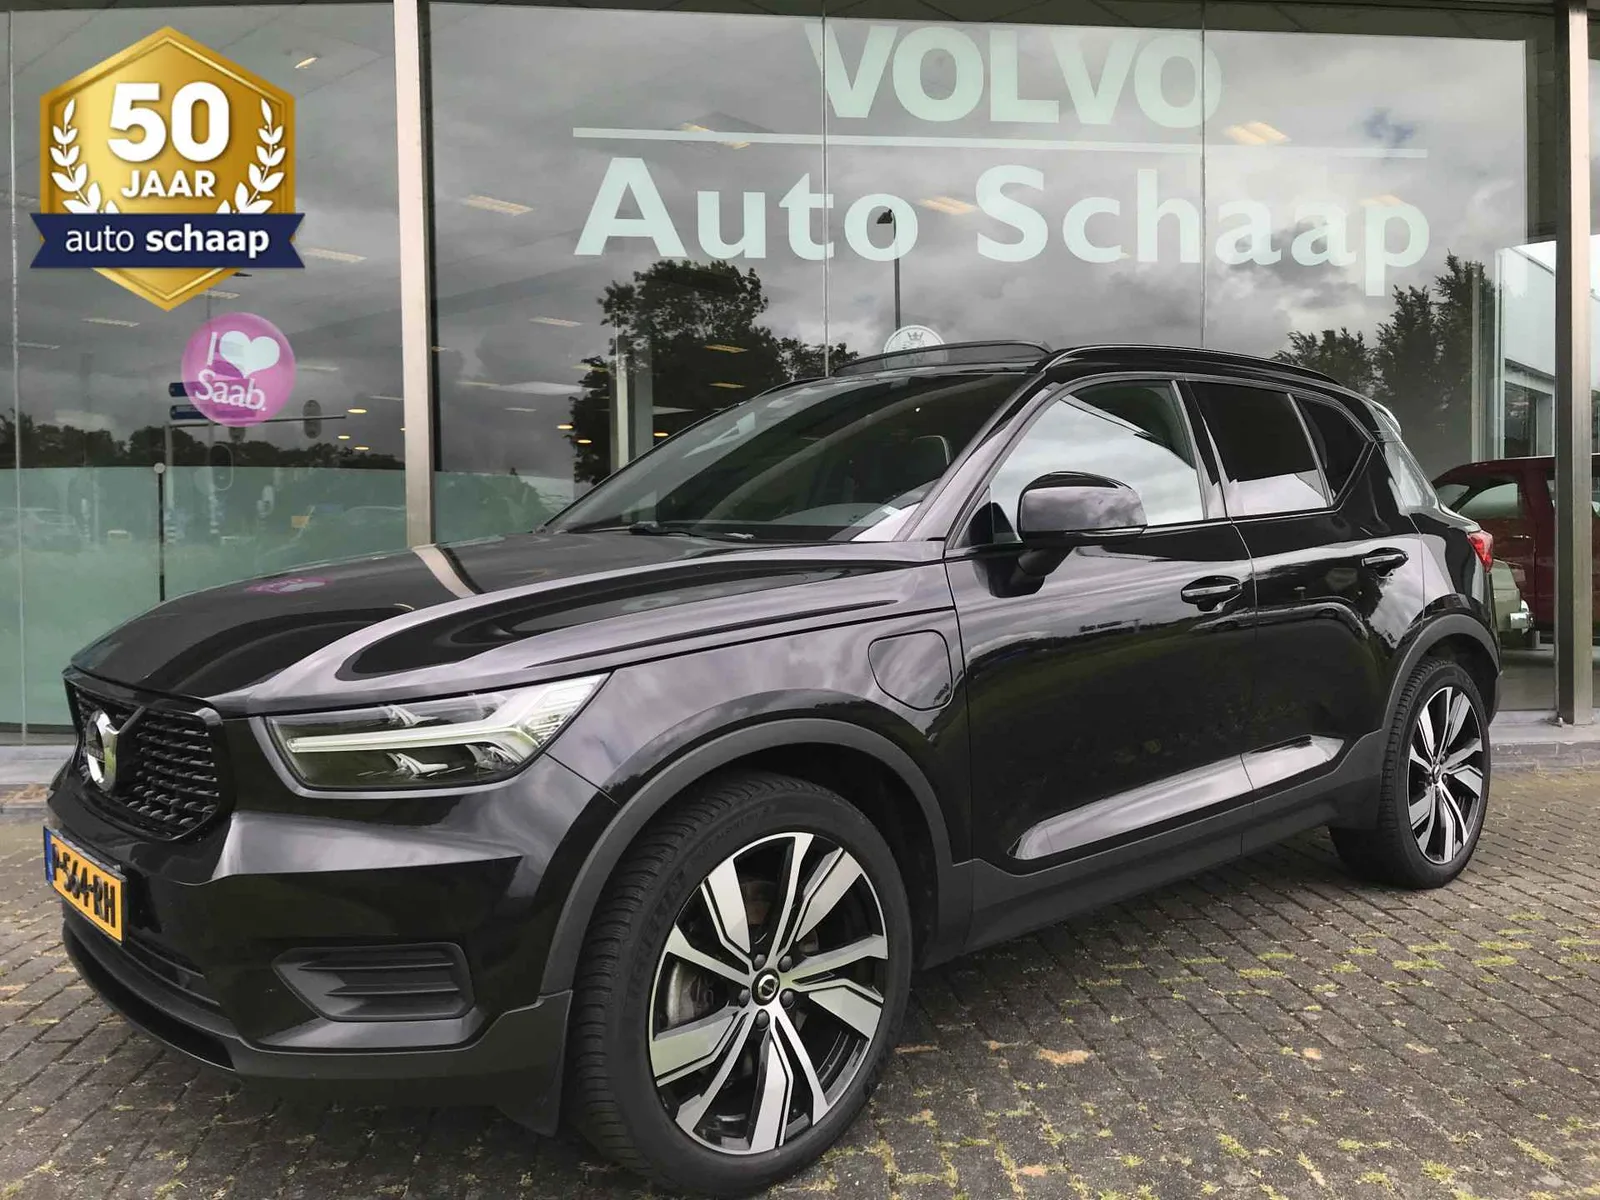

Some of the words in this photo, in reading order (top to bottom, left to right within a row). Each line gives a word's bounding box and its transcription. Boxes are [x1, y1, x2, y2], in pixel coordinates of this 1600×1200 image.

[804, 22, 1222, 128] VOLVO
[574, 157, 918, 262] Auto
[975, 165, 1430, 297] Schaap
